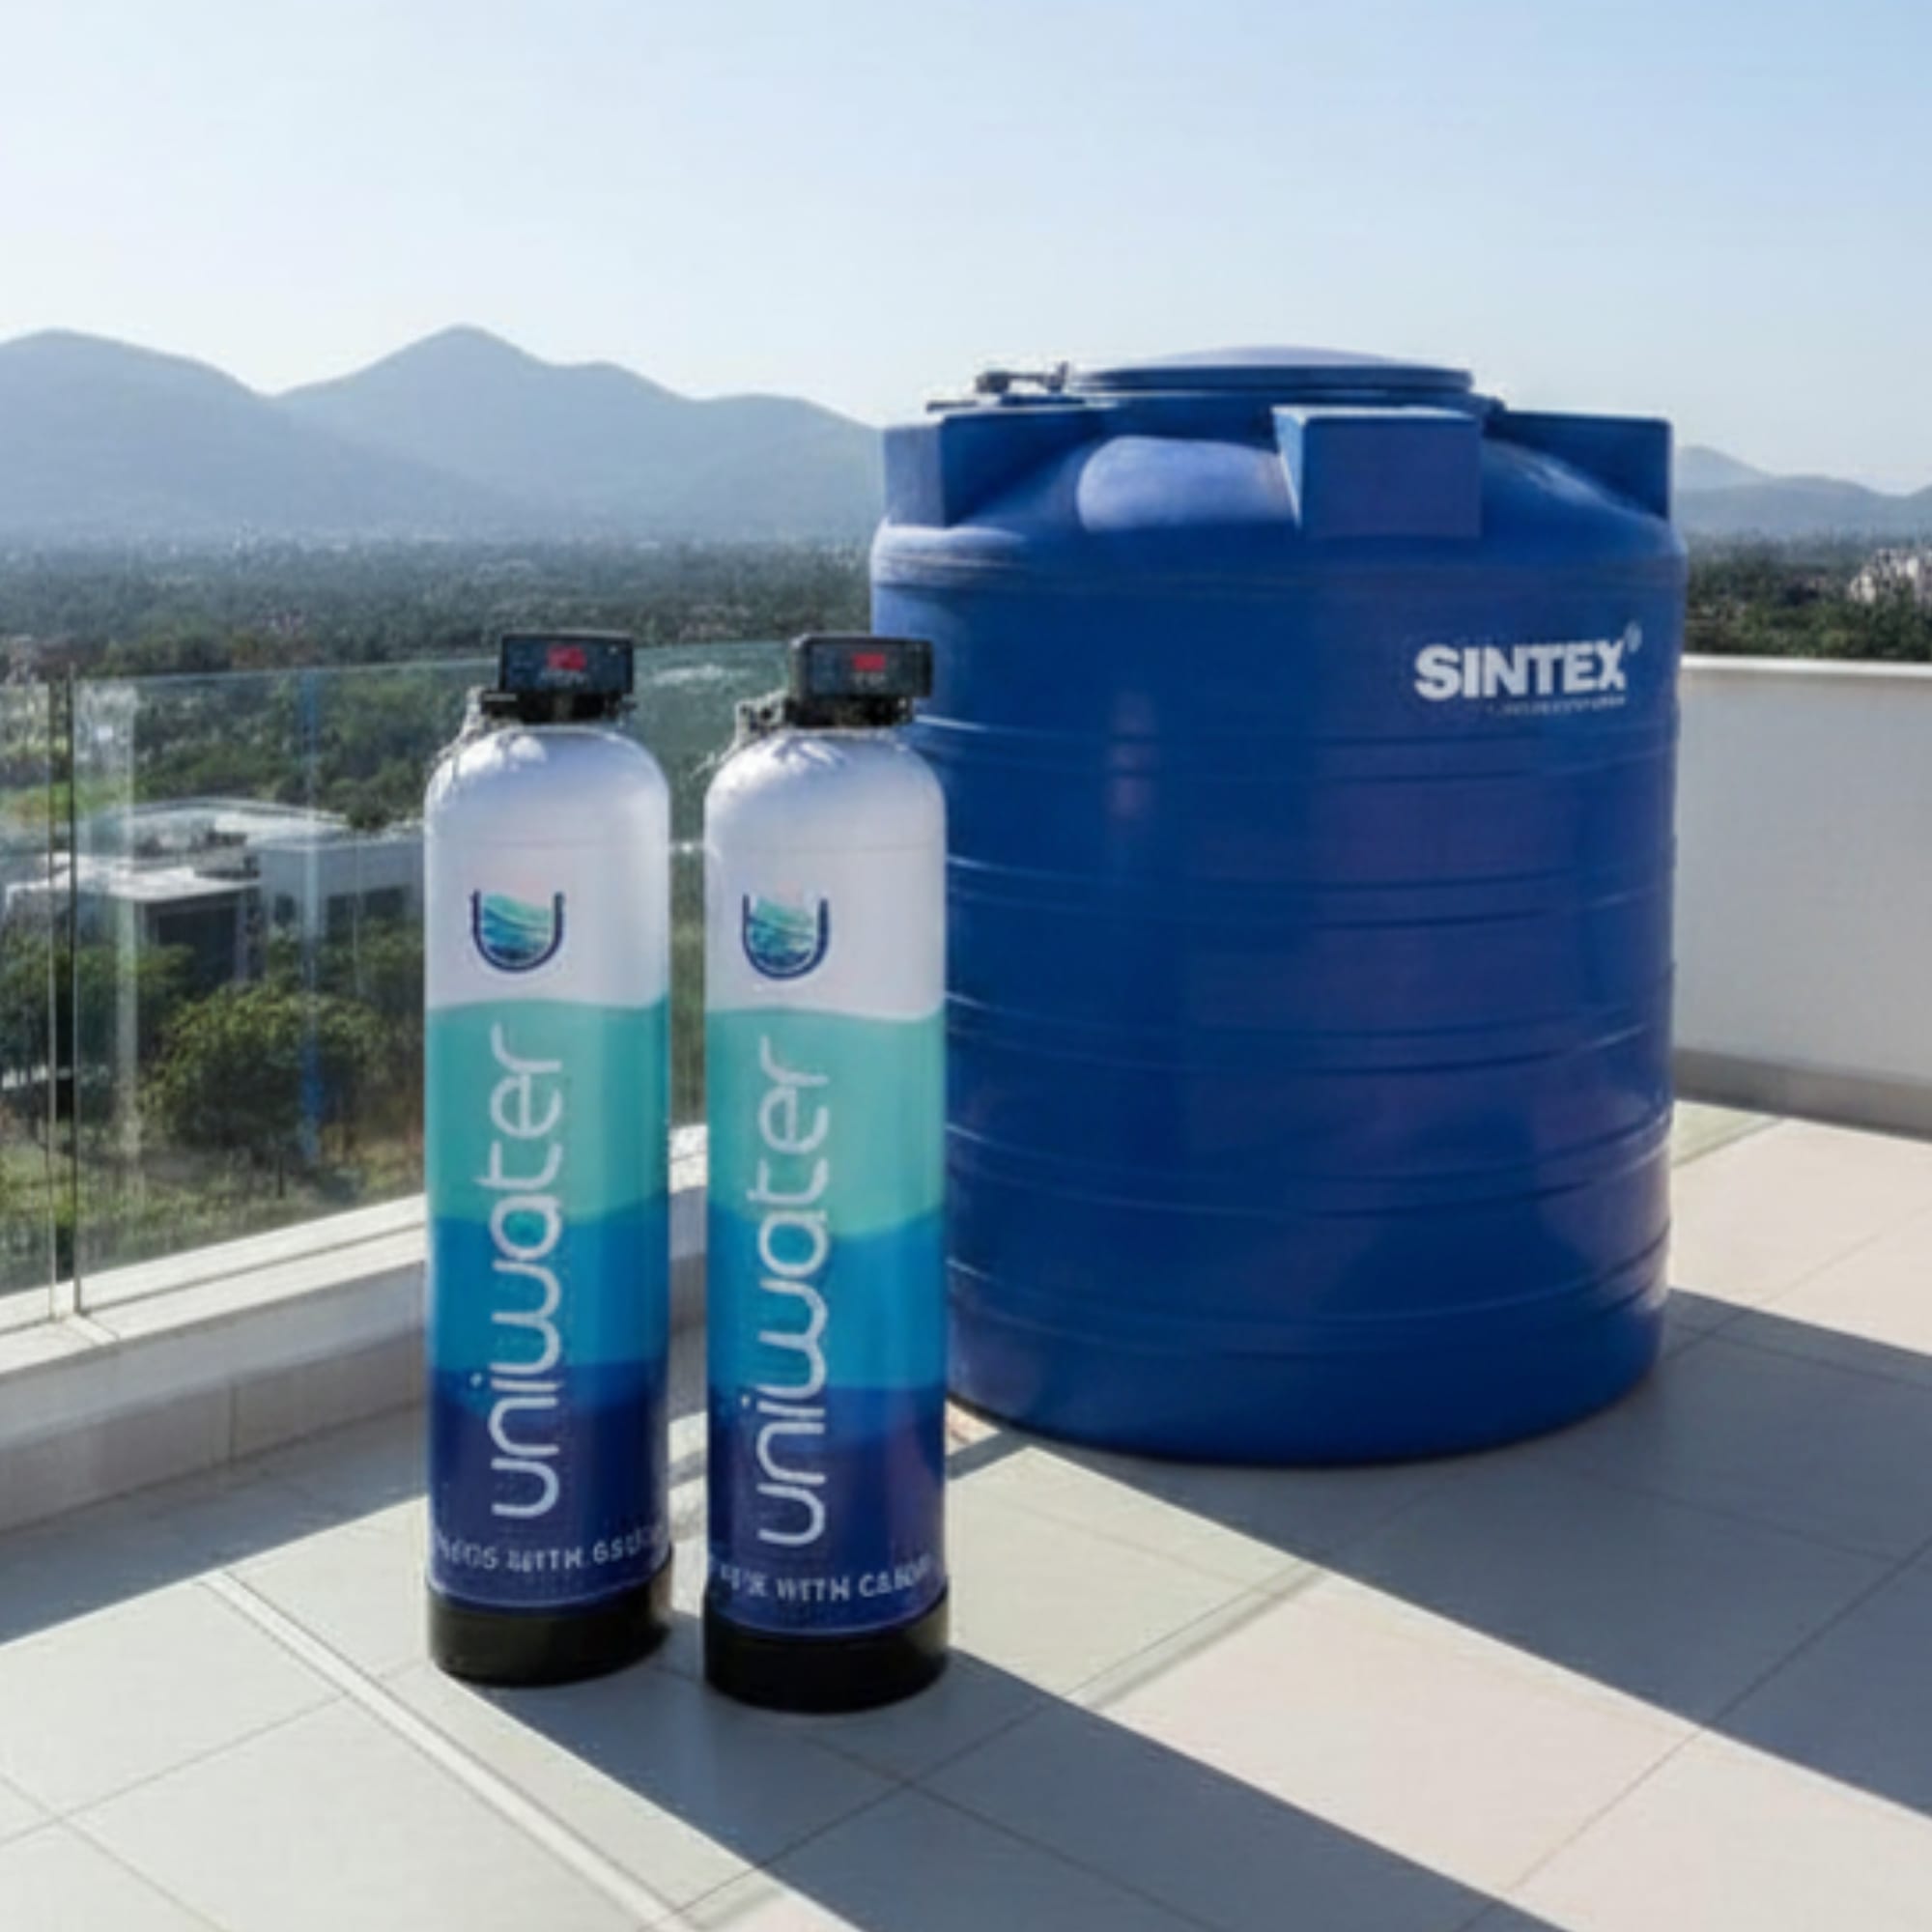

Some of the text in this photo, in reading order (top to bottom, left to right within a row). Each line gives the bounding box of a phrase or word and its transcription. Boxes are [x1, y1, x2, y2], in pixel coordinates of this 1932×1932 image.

[1414, 639, 1626, 700] SINTEX
[471, 1022, 563, 1519] uniwater
[741, 1034, 831, 1547] uniwater
